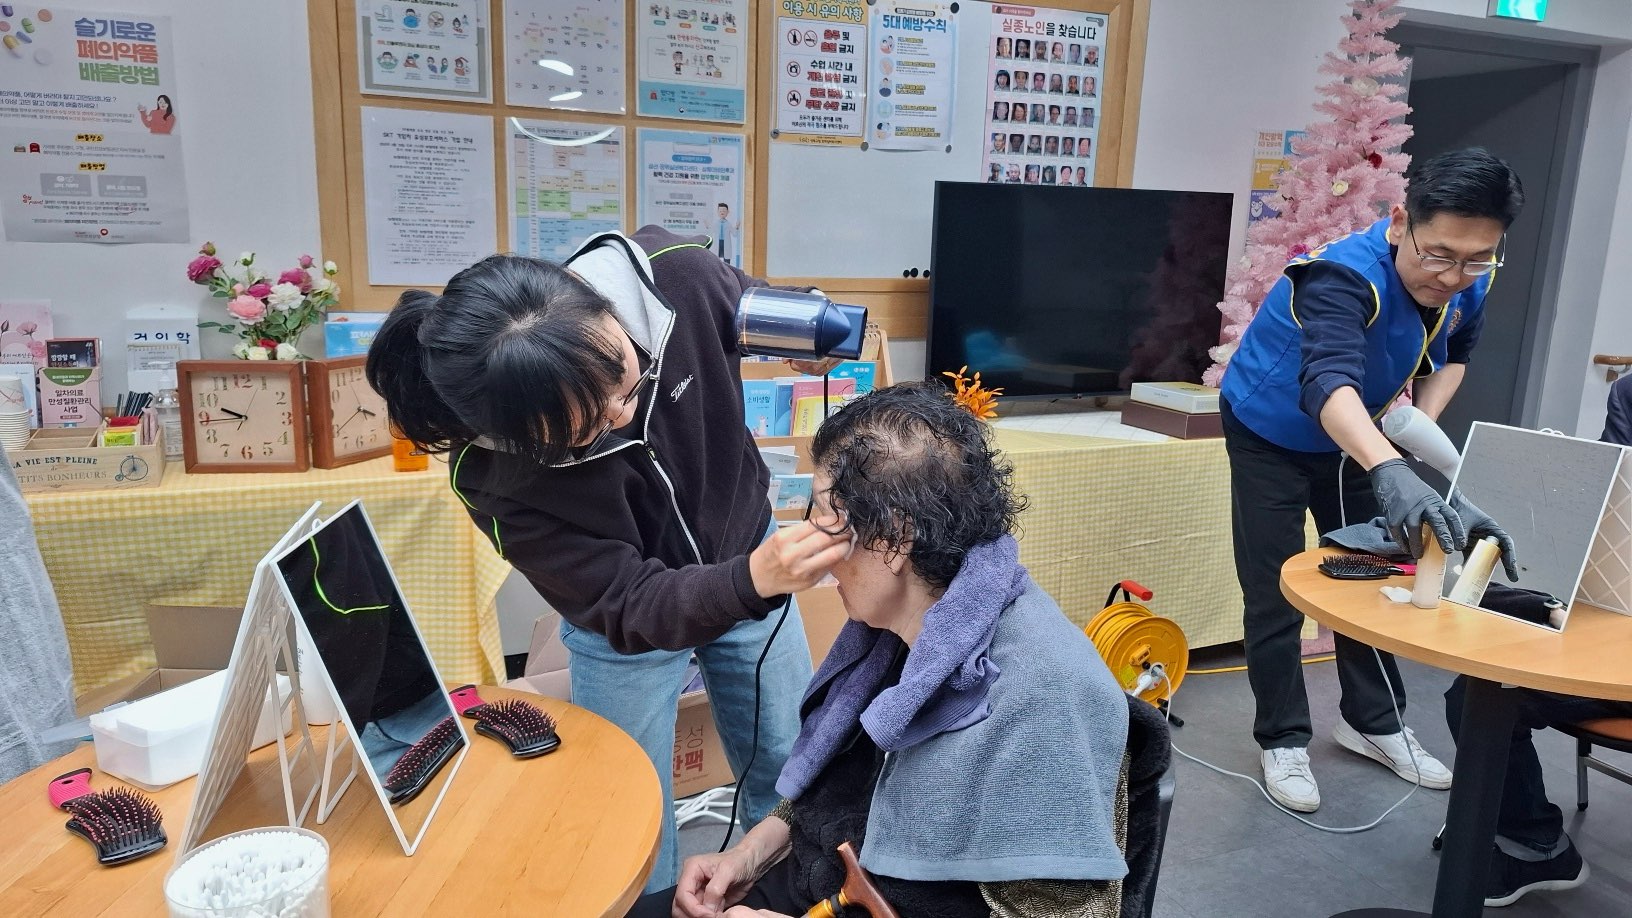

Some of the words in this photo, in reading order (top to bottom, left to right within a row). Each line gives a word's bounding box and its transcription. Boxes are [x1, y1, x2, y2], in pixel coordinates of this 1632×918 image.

[783, 2, 804, 16] 이용
[807, 3, 817, 16] 시
[819, 4, 840, 19] 유의
[843, 7, 864, 22] 사항
[75, 17, 156, 42] 슬기로운
[883, 15, 900, 29] 5대
[902, 17, 946, 33] 예방수칙
[1002, 18, 1055, 36] 실종노인을
[1058, 24, 1096, 40] 찾습니다
[842, 32, 849, 41] 및
[77, 39, 159, 64] 폐의약품
[839, 44, 854, 54] 금지
[811, 60, 826, 69] 수업
[828, 61, 843, 70] 시간
[845, 63, 853, 72] 내
[79, 62, 160, 86] 배출방법
[843, 75, 857, 84] 금지
[841, 103, 855, 112] 금지
[233, 374, 253, 389] 12
[261, 376, 267, 390] 1
[336, 373, 346, 387] 11
[349, 368, 361, 383] 12
[213, 376, 227, 391] 11
[55, 389, 84, 397] 일차의료
[199, 392, 218, 408] 10
[276, 391, 287, 405] 2
[747, 396, 771, 404] 소비생활
[48, 398, 92, 406] 만성질환관리
[199, 411, 209, 426] 9
[281, 411, 292, 426] 3
[206, 428, 218, 443] 8
[277, 431, 288, 445] 4
[356, 434, 364, 449] 6
[220, 443, 230, 457] 7
[241, 445, 253, 460] 6
[263, 441, 273, 456] 5
[13, 461, 21, 469] A
[25, 458, 41, 466] VIE
[45, 456, 61, 464] EST
[65, 456, 98, 465] PLEINE
[18, 475, 44, 484] TITS
[47, 471, 107, 481] BONHEURS
